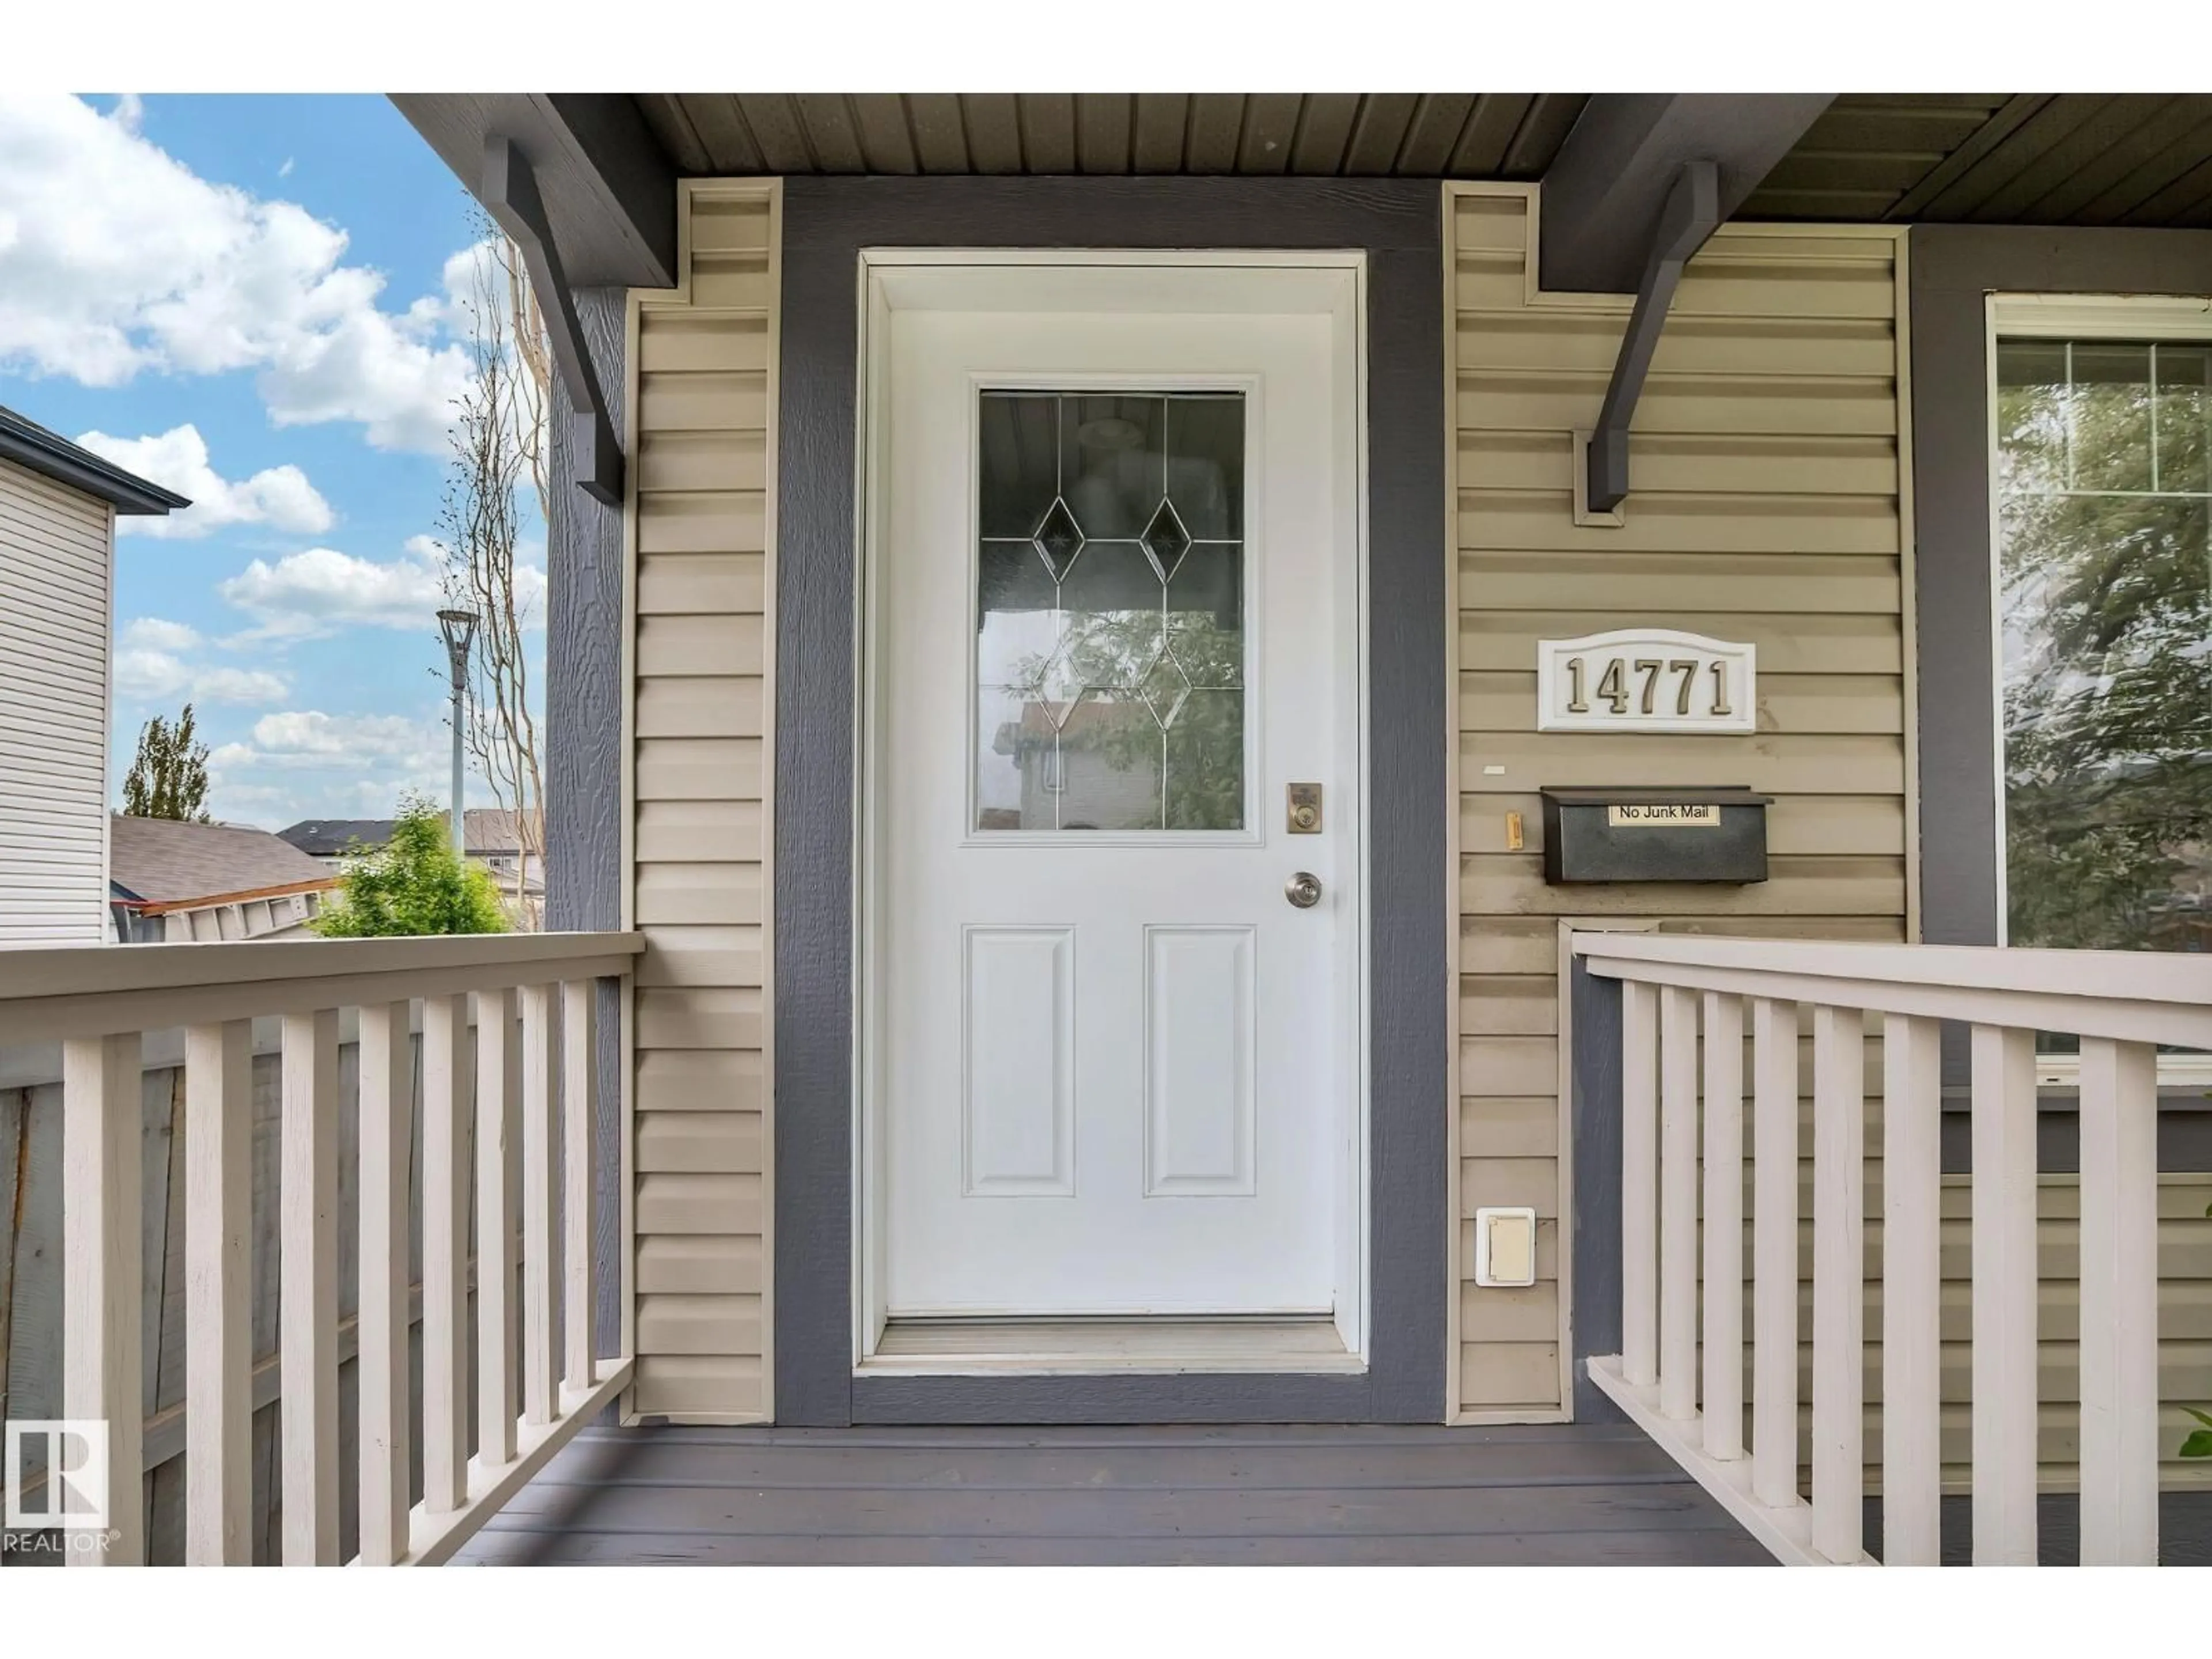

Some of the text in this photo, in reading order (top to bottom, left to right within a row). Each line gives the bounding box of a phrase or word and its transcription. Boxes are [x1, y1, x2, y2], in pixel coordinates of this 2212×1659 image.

[1567, 657, 1732, 714] 14771
[1620, 805, 1709, 818] No Junk Mail
